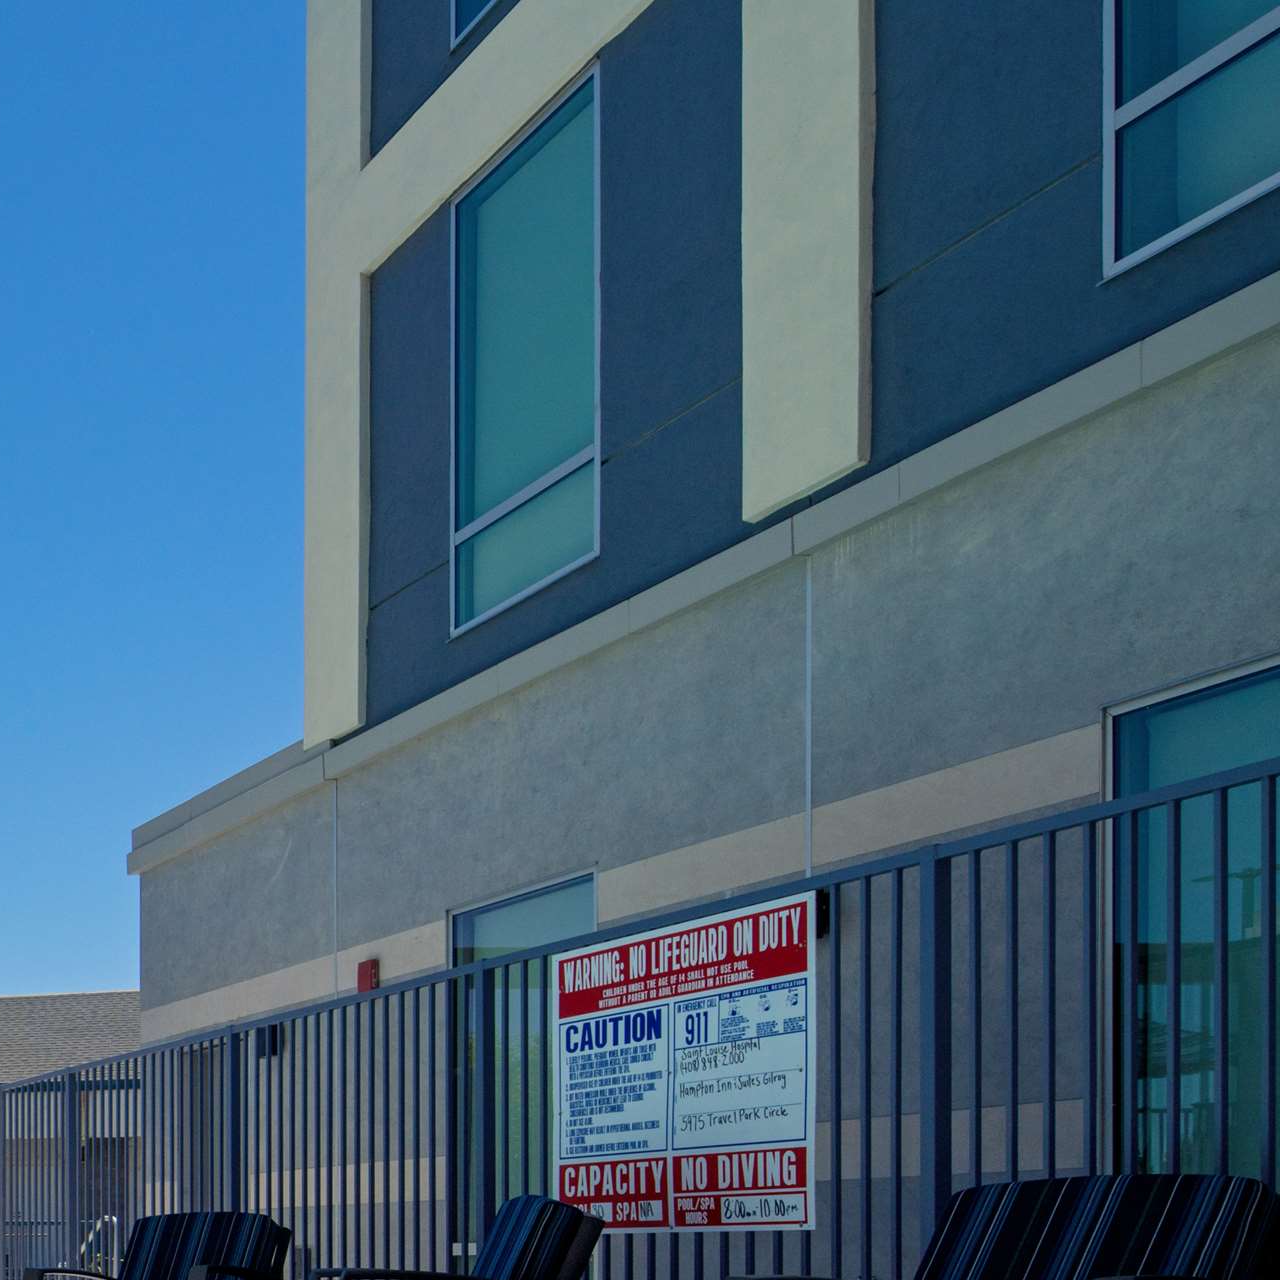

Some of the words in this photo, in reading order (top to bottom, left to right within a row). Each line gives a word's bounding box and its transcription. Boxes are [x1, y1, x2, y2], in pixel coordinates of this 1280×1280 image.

[563, 950, 625, 993] WARNING:
[629, 943, 647, 980] NO
[651, 925, 727, 975] LIFEGUARD
[733, 919, 753, 957] ON
[759, 907, 801, 952] DUTY
[598, 996, 621, 1009] WITHOUT
[627, 991, 648, 1003] PARENT
[649, 988, 657, 998] OR
[658, 985, 676, 997] ADULT
[677, 980, 705, 993] GUARDIAN
[715, 969, 755, 985] ATTENDANCE
[603, 985, 627, 998] CHILDREN
[628, 981, 645, 993] UNDER
[646, 979, 657, 989] THE
[658, 975, 669, 986] AGE
[670, 974, 678, 985] OF
[687, 970, 705, 981] SHALL
[707, 966, 718, 977] NOT
[720, 963, 732, 974] USE
[733, 960, 749, 971] POOL
[682, 999, 705, 1013] EMERGENCY
[706, 997, 717, 1008] CALL
[565, 1008, 662, 1053] CAUTION
[685, 1011, 708, 1046] 911
[731, 1039, 761, 1054] Hospital
[679, 1081, 714, 1098] Hampton
[717, 1079, 732, 1093] Inn
[763, 1072, 787, 1089] Gilroy
[707, 1111, 737, 1127] Travel
[763, 1106, 789, 1119] Circle
[564, 1160, 664, 1198] CAPACITY
[681, 1157, 707, 1191] NO
[717, 1150, 797, 1189] DIVING
[616, 1201, 638, 1221] SPA
[677, 1197, 716, 1211] POOL/SPA
[685, 1212, 709, 1225] HOURS
